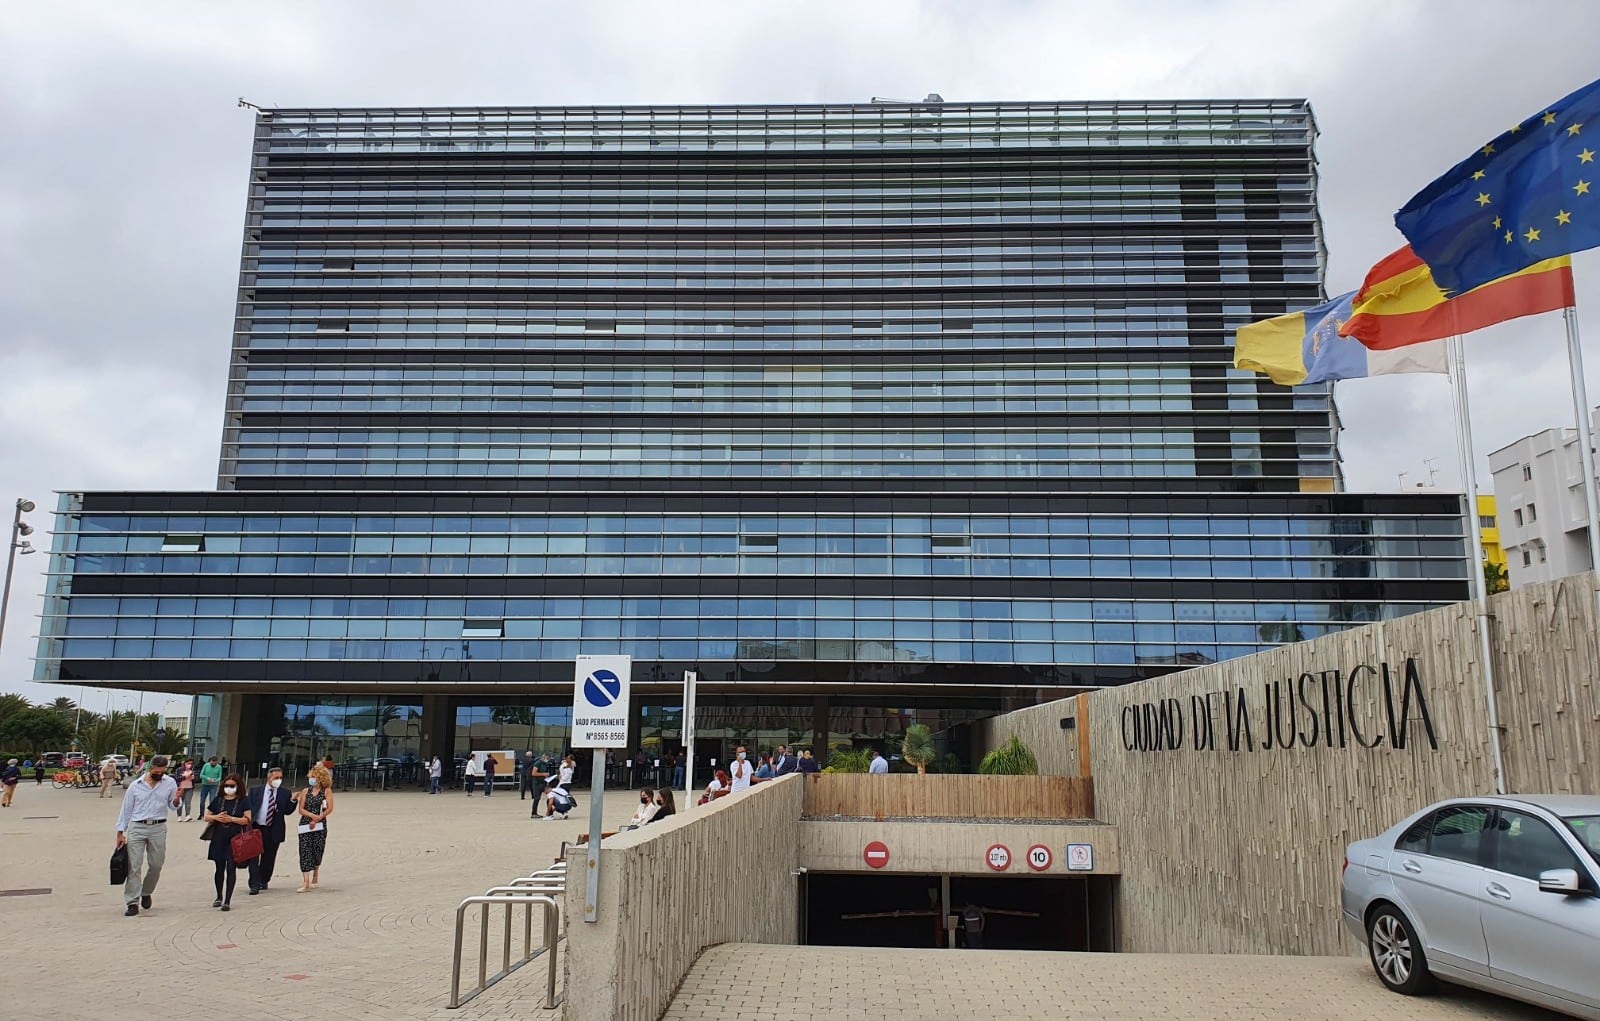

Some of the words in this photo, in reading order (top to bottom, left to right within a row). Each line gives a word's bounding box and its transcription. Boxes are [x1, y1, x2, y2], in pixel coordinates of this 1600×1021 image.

[1121, 697, 1183, 752] CIUDAD
[1191, 692, 1218, 751] DE
[1225, 687, 1253, 752] LA
[1262, 657, 1438, 750] JUSTICIA
[575, 718, 589, 726] VADO
[590, 718, 625, 726] PERMANENTE
[1033, 852, 1046, 863] 10
